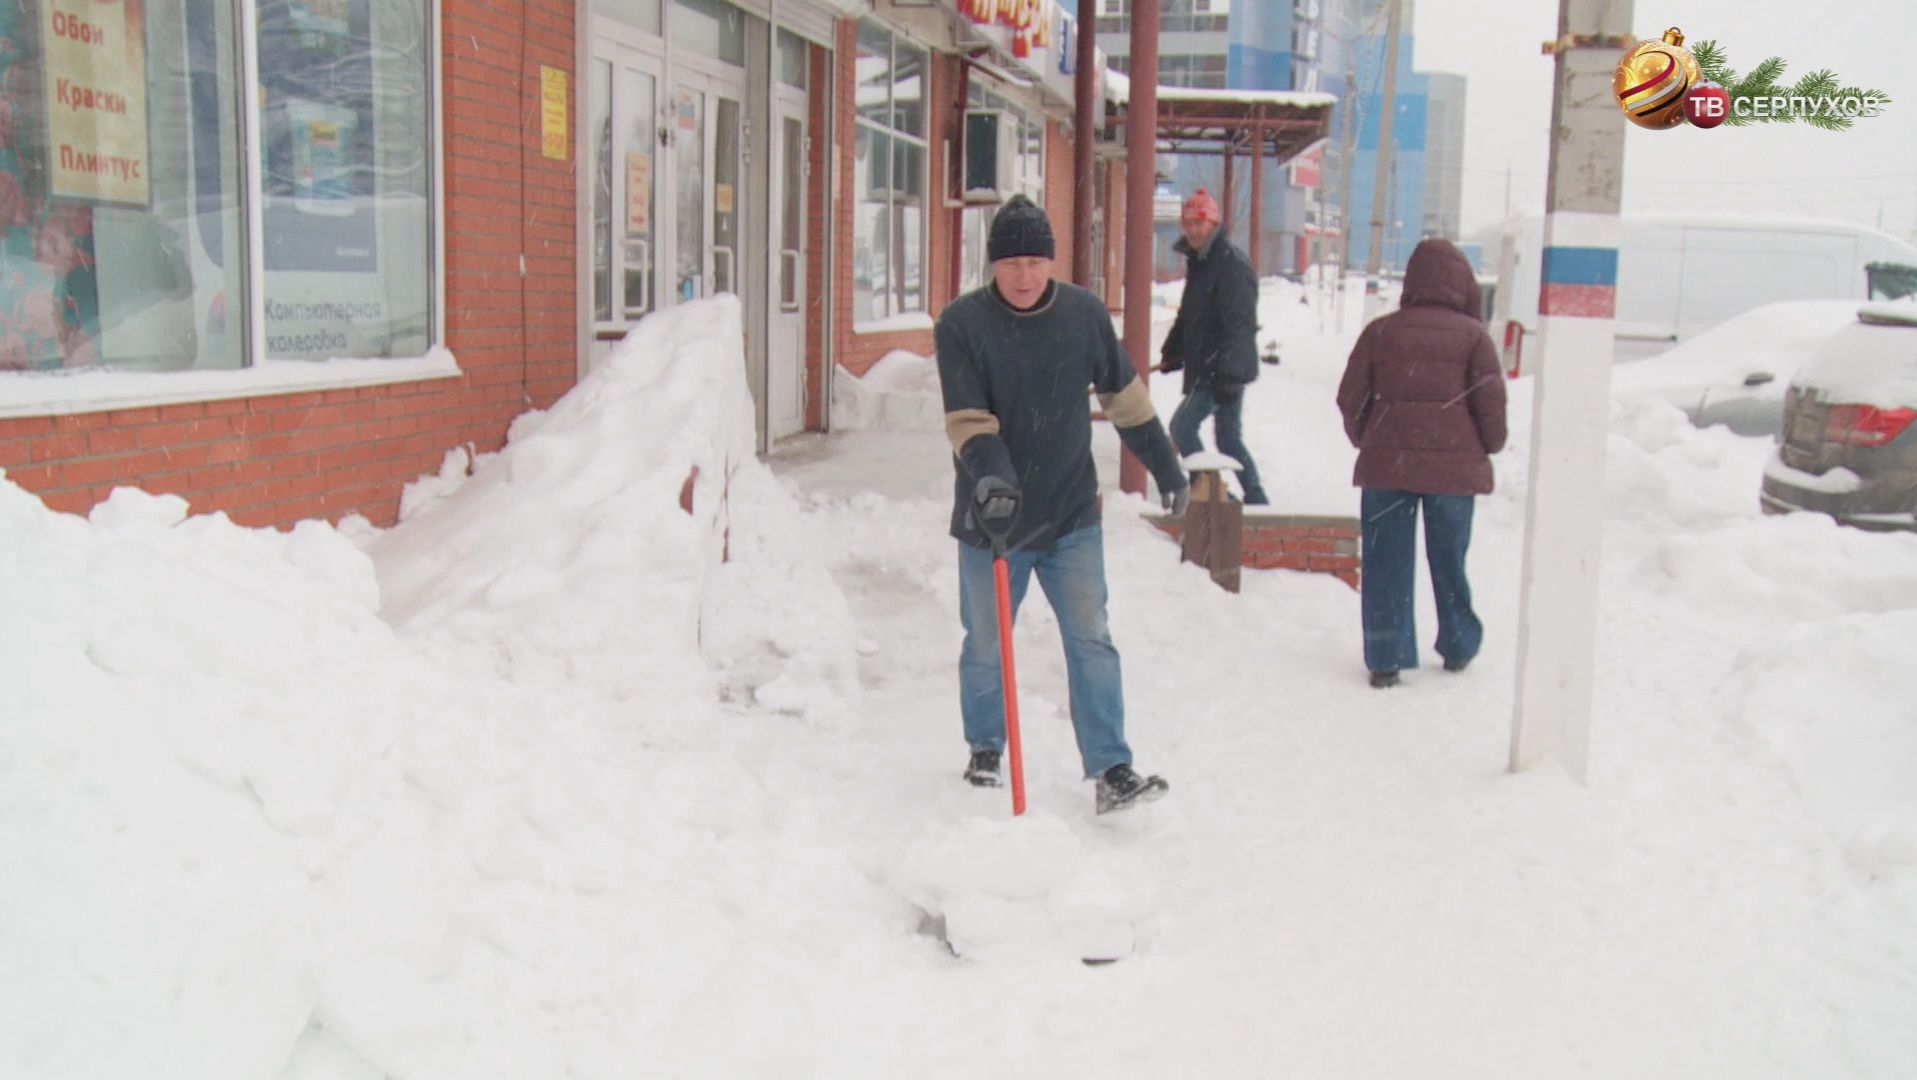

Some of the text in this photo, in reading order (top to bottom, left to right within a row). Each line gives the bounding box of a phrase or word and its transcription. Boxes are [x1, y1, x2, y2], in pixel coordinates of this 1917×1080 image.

[53, 11, 104, 45] Обои
[57, 78, 126, 114] Краски
[60, 144, 141, 181] Плинтус
[264, 300, 382, 323] Компьютерная
[267, 329, 347, 353] колеровка
